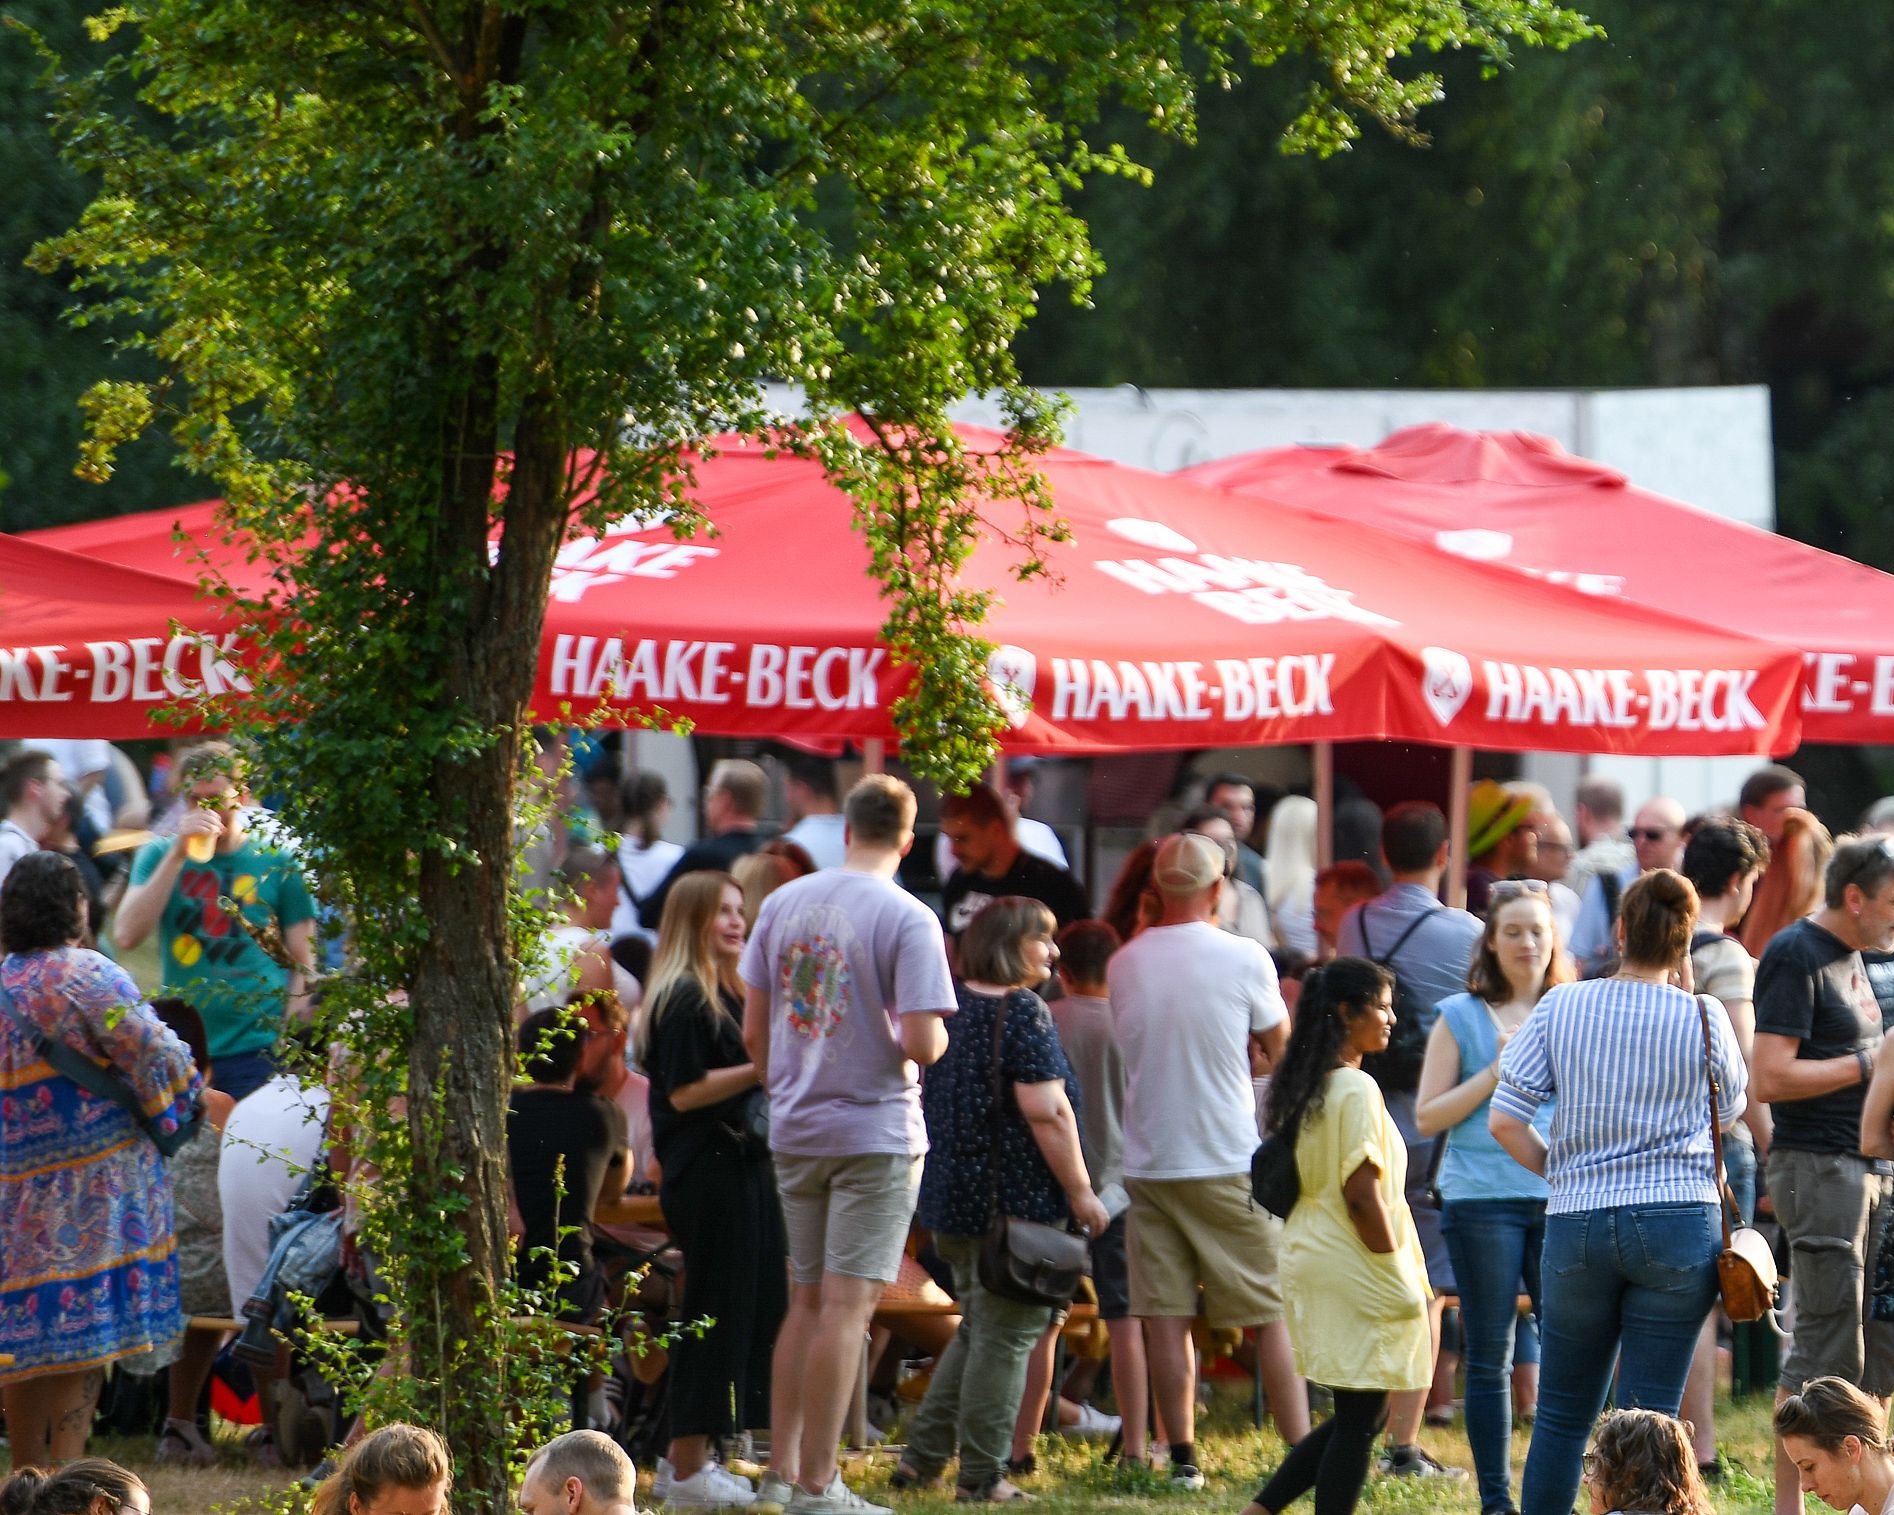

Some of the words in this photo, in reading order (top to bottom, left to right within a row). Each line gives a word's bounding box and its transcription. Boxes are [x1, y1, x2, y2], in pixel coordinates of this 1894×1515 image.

[551, 633, 887, 710] HAAKE-BECK
[1051, 652, 1337, 721] HAAKE-BECK
[1482, 659, 1769, 732] HAAKE-BECK
